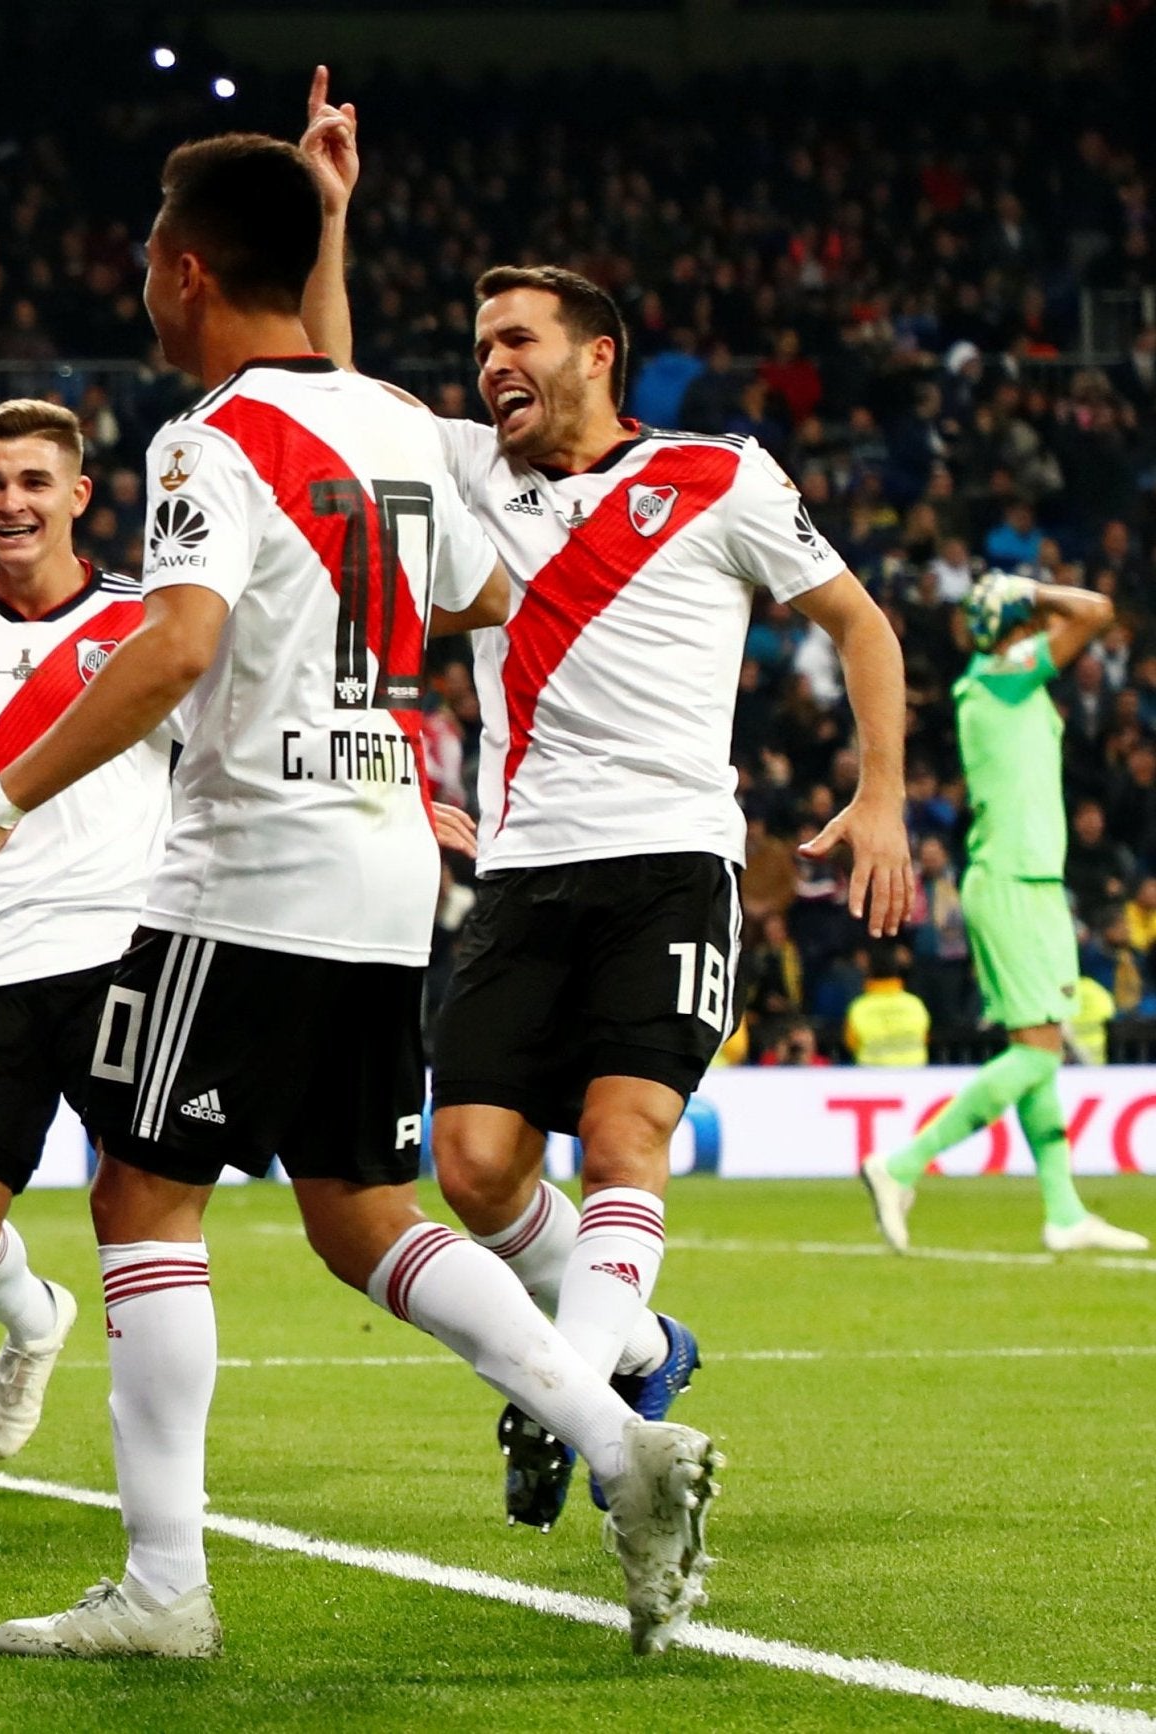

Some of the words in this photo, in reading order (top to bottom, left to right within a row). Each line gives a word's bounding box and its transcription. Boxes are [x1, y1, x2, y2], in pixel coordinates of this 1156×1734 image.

[504, 502, 544, 517] adidas
[147, 554, 207, 572] AWEI
[308, 478, 435, 711] 10
[282, 730, 314, 780] G.
[330, 730, 420, 785] MARTI
[668, 942, 725, 1033] 18
[90, 984, 147, 1085] 0
[180, 1103, 227, 1125] adidas
